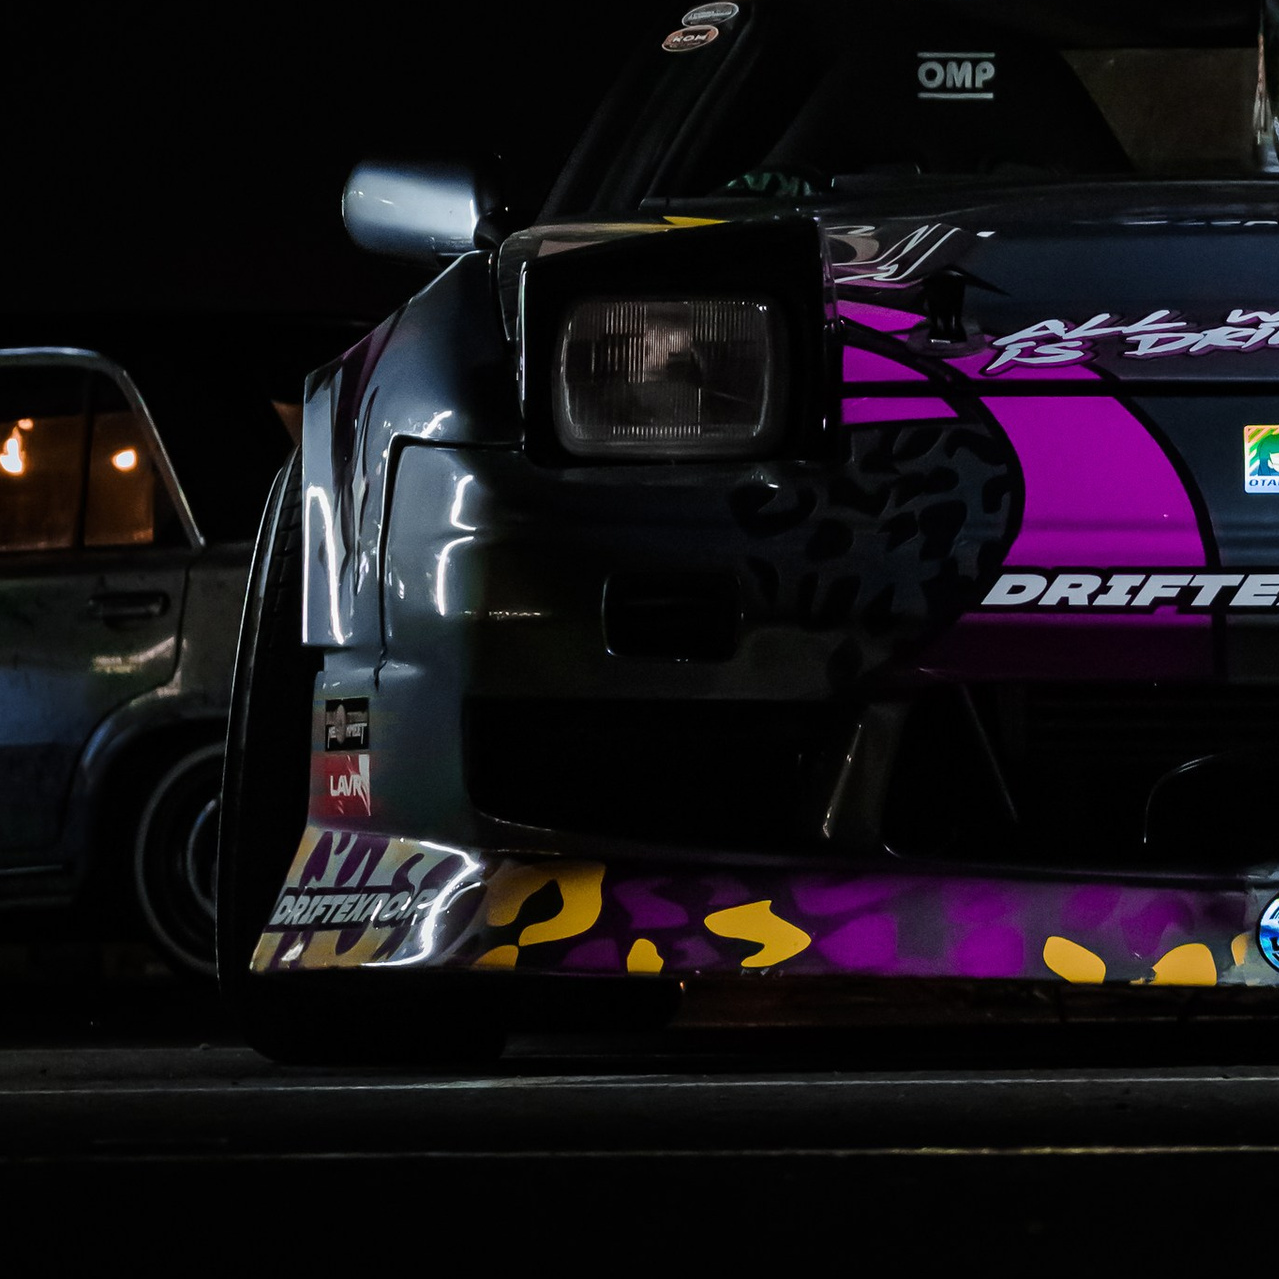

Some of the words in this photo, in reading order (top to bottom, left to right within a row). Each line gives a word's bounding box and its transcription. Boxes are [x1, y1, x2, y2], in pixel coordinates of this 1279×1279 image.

[917, 60, 996, 89] OMP
[992, 309, 1188, 345] ALL
[986, 340, 1086, 372] IS
